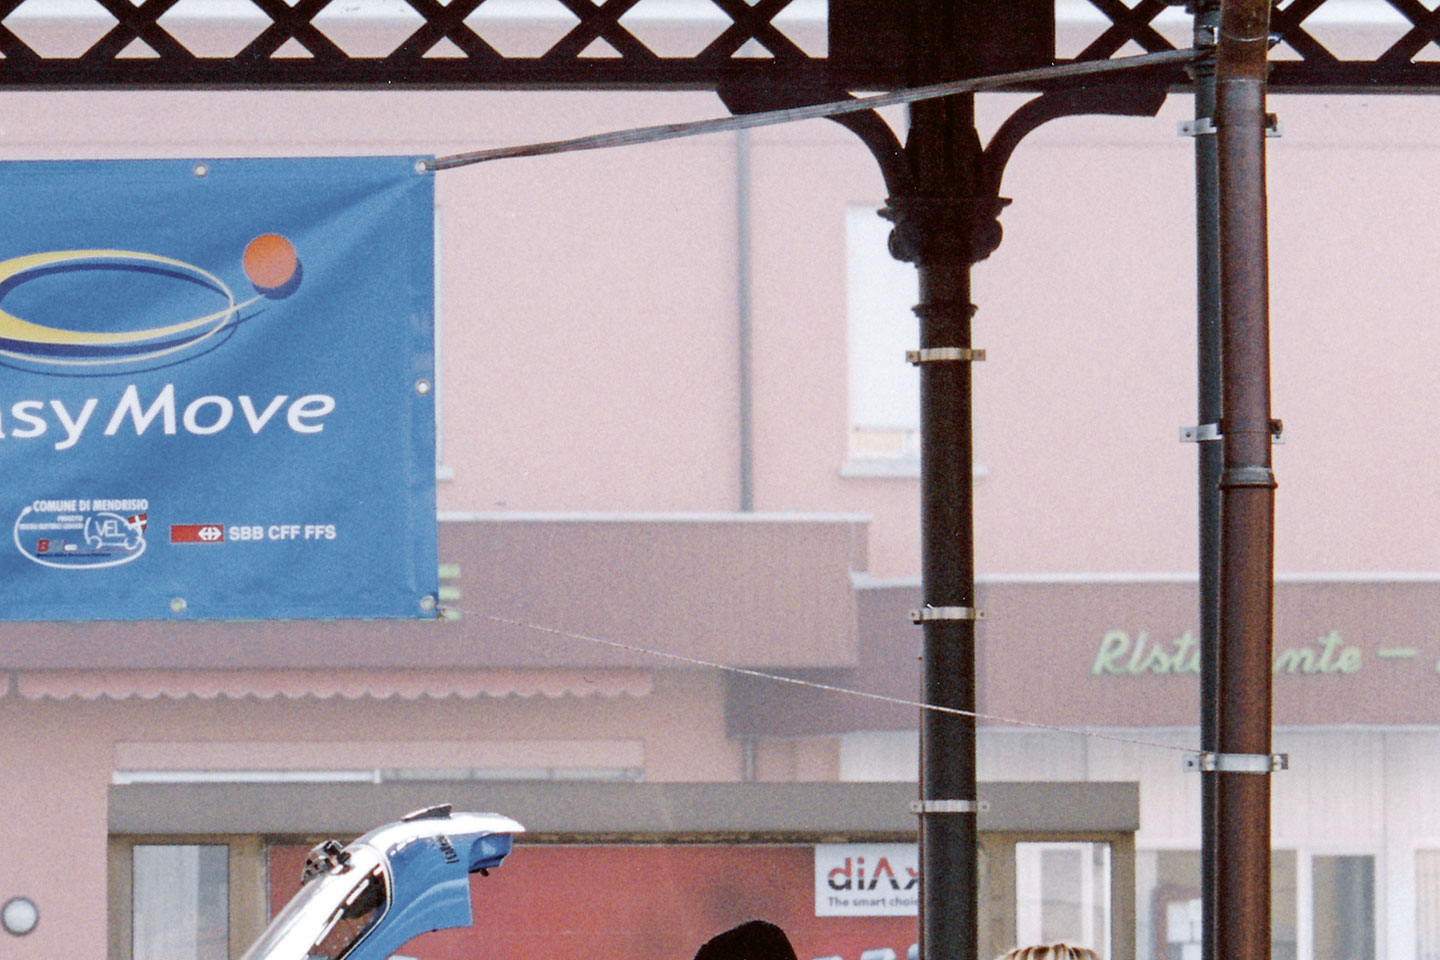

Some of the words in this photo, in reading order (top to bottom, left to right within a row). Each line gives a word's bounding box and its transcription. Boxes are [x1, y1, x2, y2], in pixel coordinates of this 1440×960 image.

[32, 500, 78, 512] COMUNE
[79, 499, 91, 511] DI
[92, 498, 149, 511] MENDRISIO
[229, 525, 264, 541] SBB
[267, 525, 301, 540] CFF
[304, 524, 337, 540] FFS
[829, 897, 849, 907] The
[853, 897, 887, 907] smart
